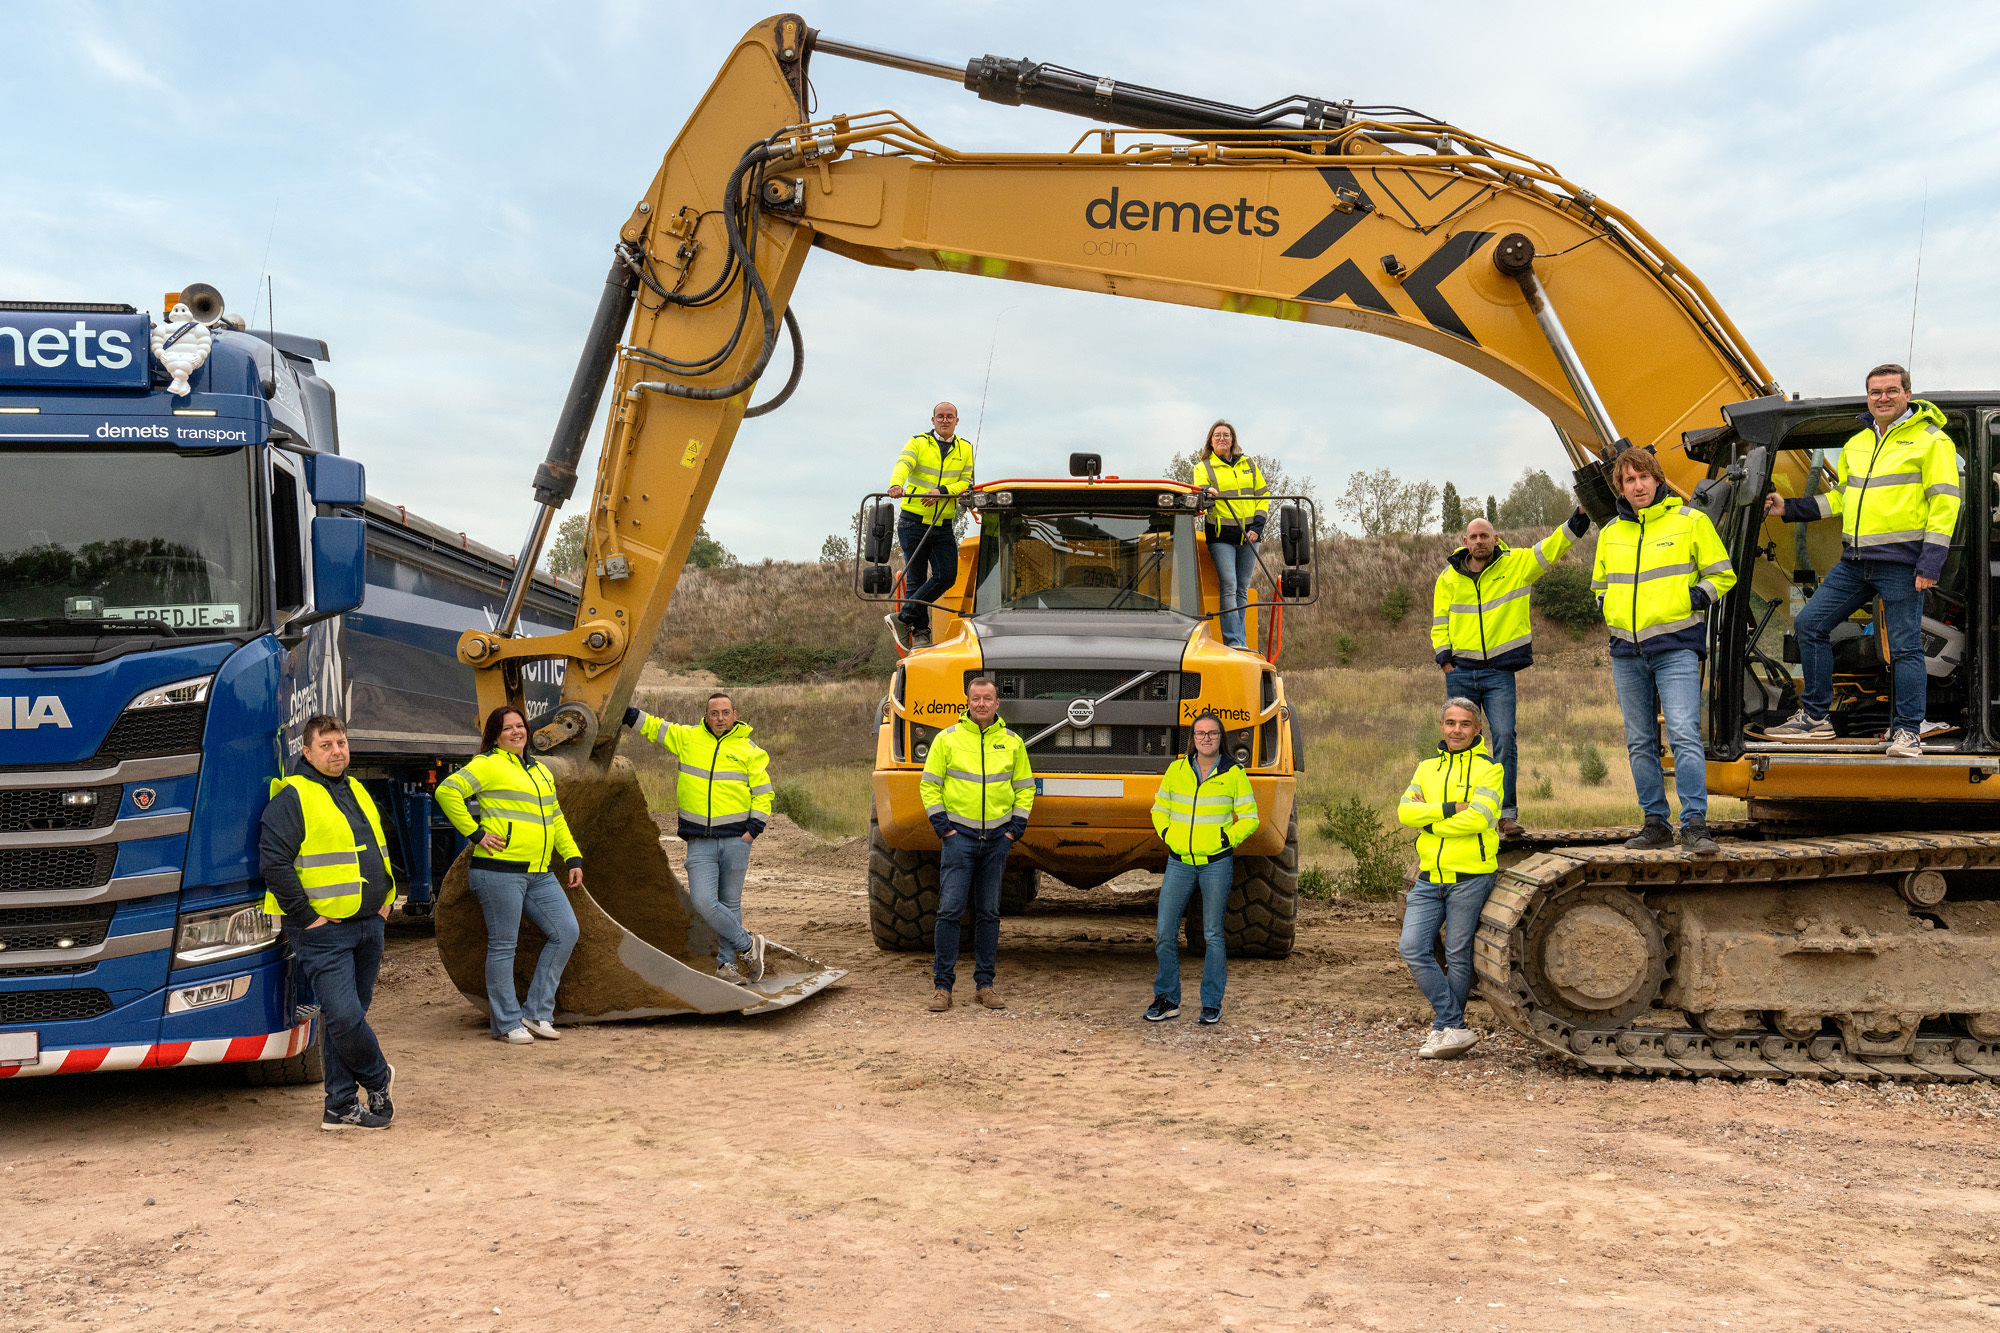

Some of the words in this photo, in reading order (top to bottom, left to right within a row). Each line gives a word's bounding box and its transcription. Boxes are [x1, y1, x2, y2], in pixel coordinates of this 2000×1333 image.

[1085, 186, 1280, 237] demets
[96, 422, 170, 438] demets
[176, 427, 247, 442] transport
[926, 699, 969, 714] deme
